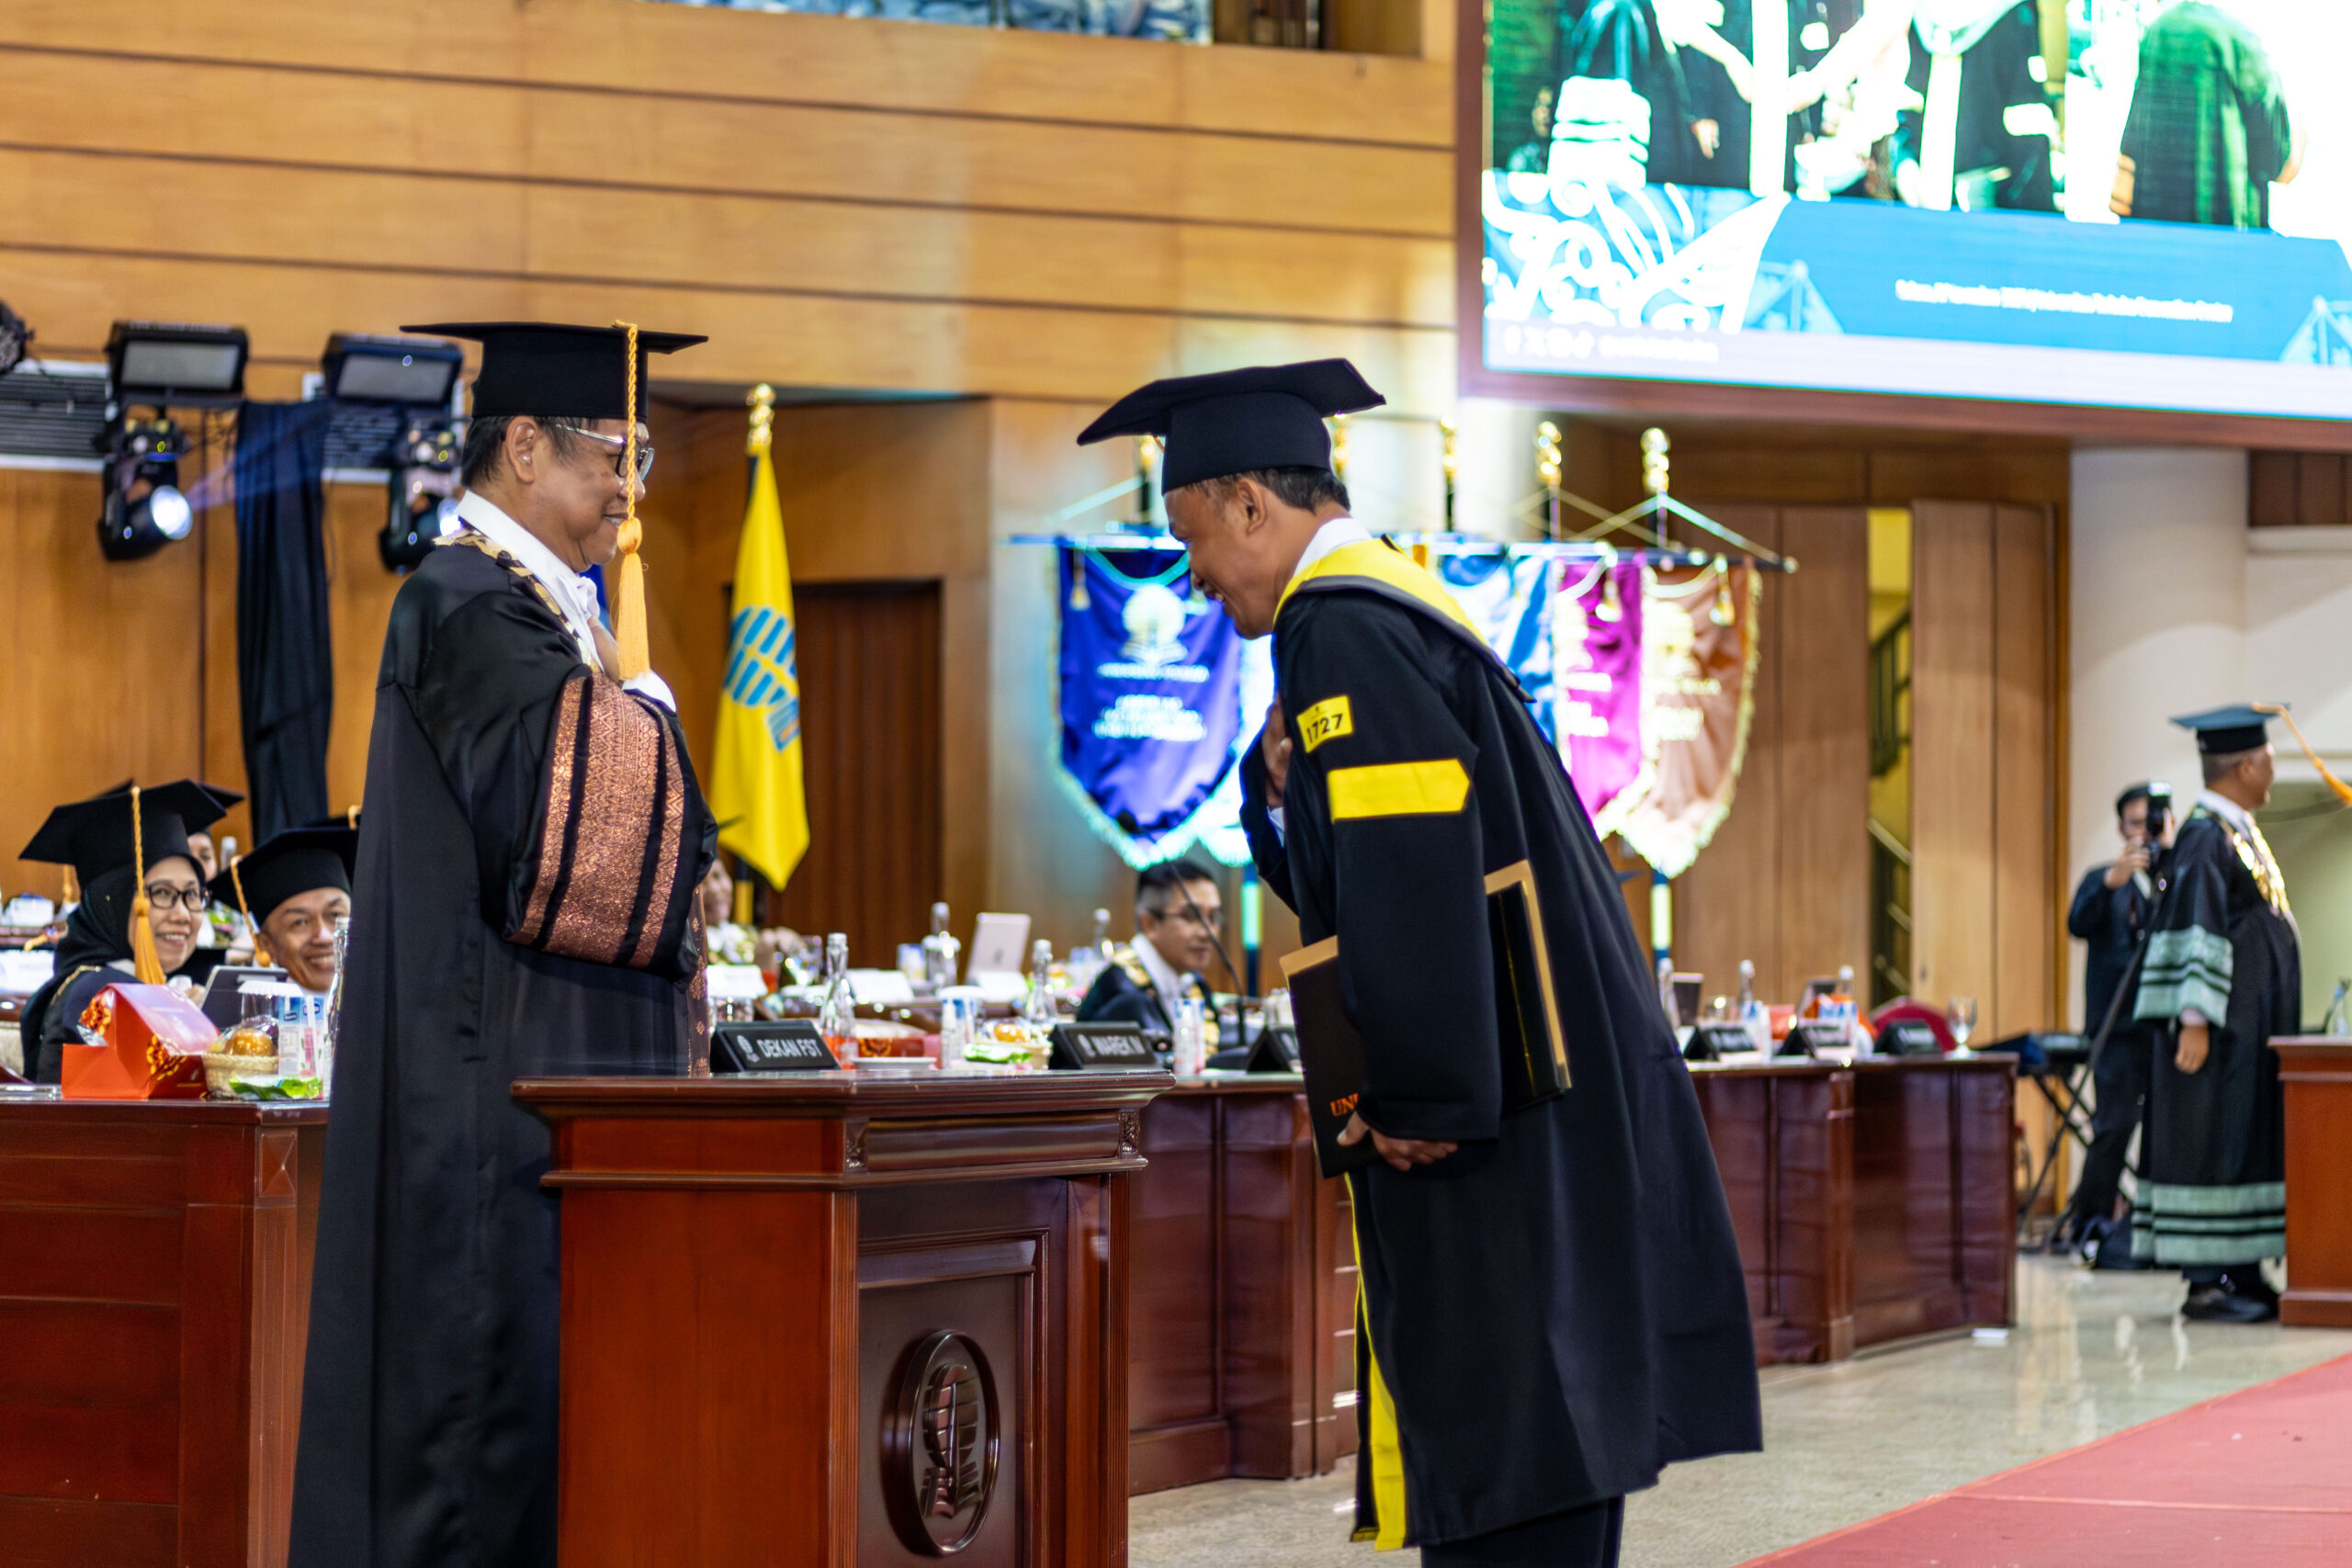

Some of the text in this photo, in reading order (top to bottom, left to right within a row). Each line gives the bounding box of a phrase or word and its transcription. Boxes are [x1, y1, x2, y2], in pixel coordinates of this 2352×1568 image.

[1306, 713, 1343, 743] 1727
[756, 1039, 822, 1057] DEKAN FST
